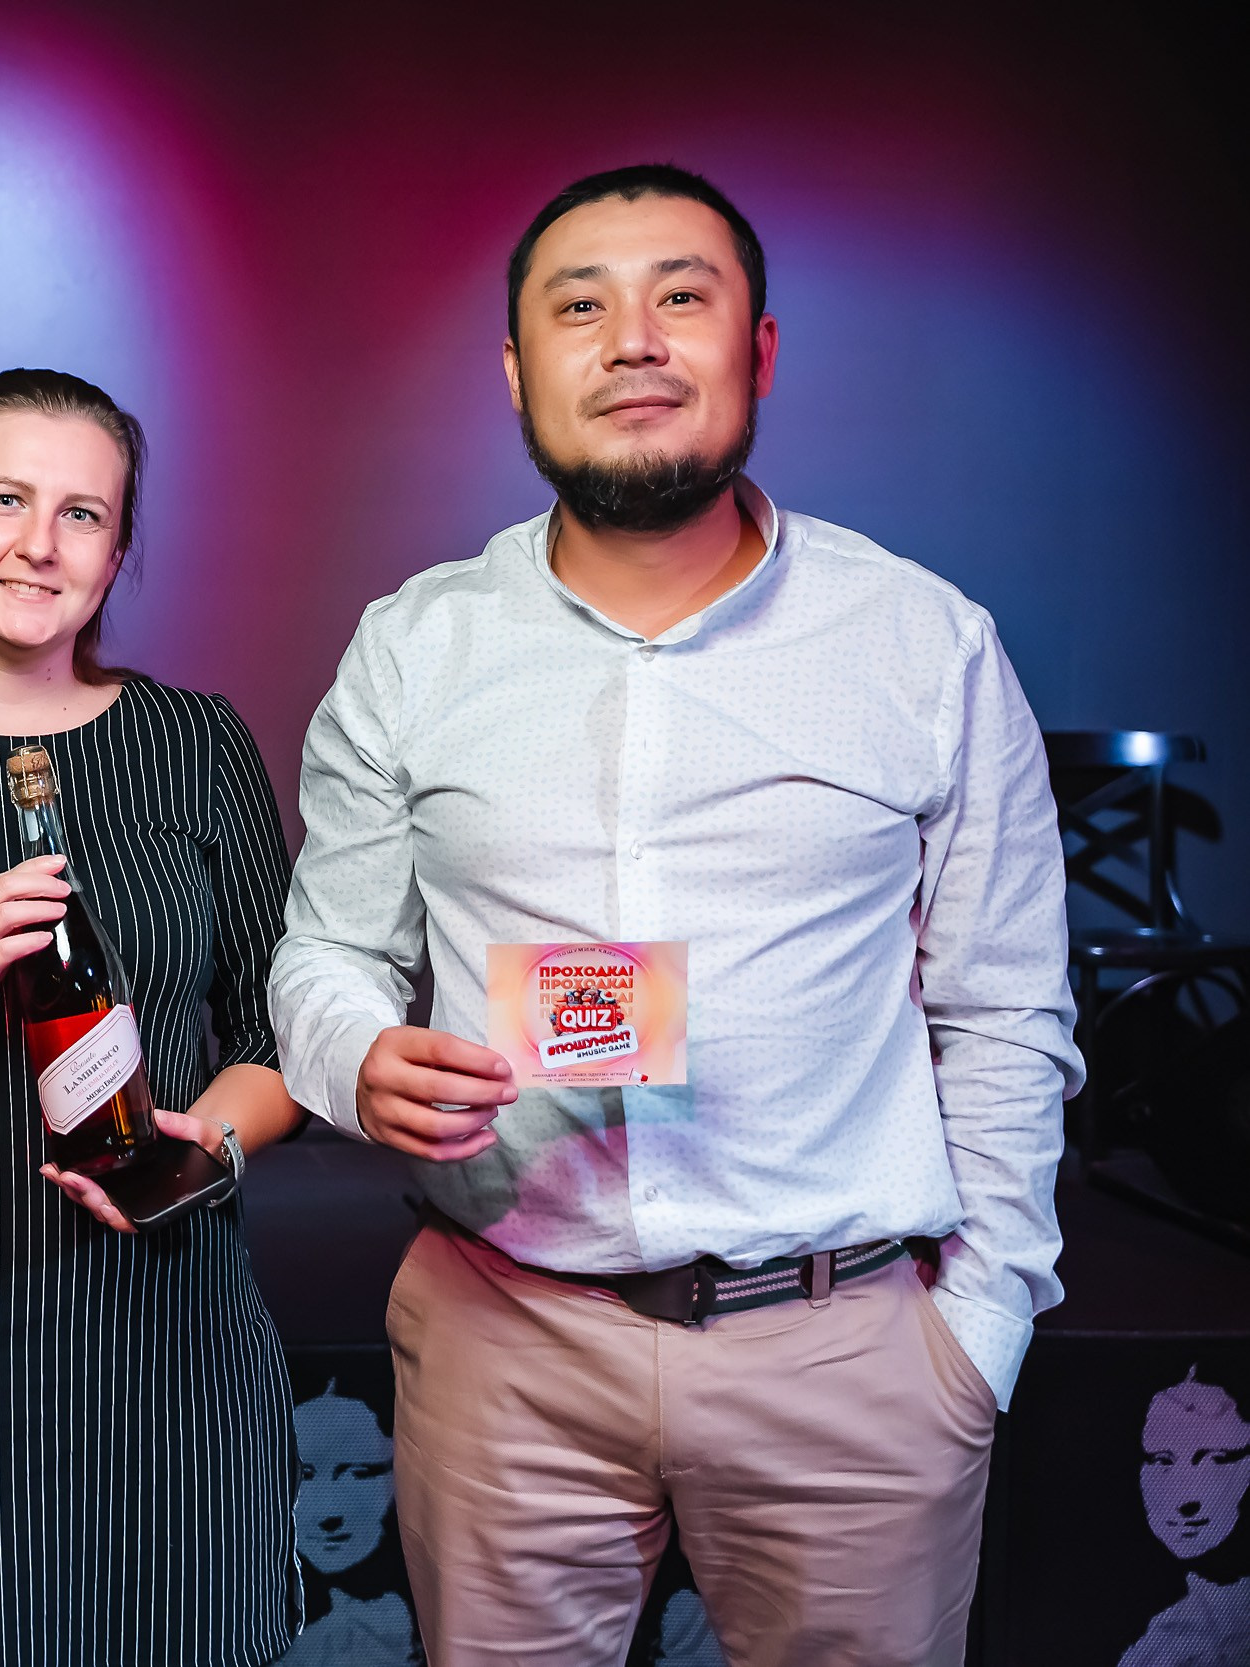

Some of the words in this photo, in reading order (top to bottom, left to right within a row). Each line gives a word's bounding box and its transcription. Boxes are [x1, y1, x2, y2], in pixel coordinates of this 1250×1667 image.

[539, 965, 634, 977] ПРОХОДКА!
[539, 978, 634, 990] ПРОХОДКА!
[560, 1009, 612, 1028] QUIZ
[577, 1047, 607, 1058] #MUSIC
[609, 1042, 630, 1052] GAME
